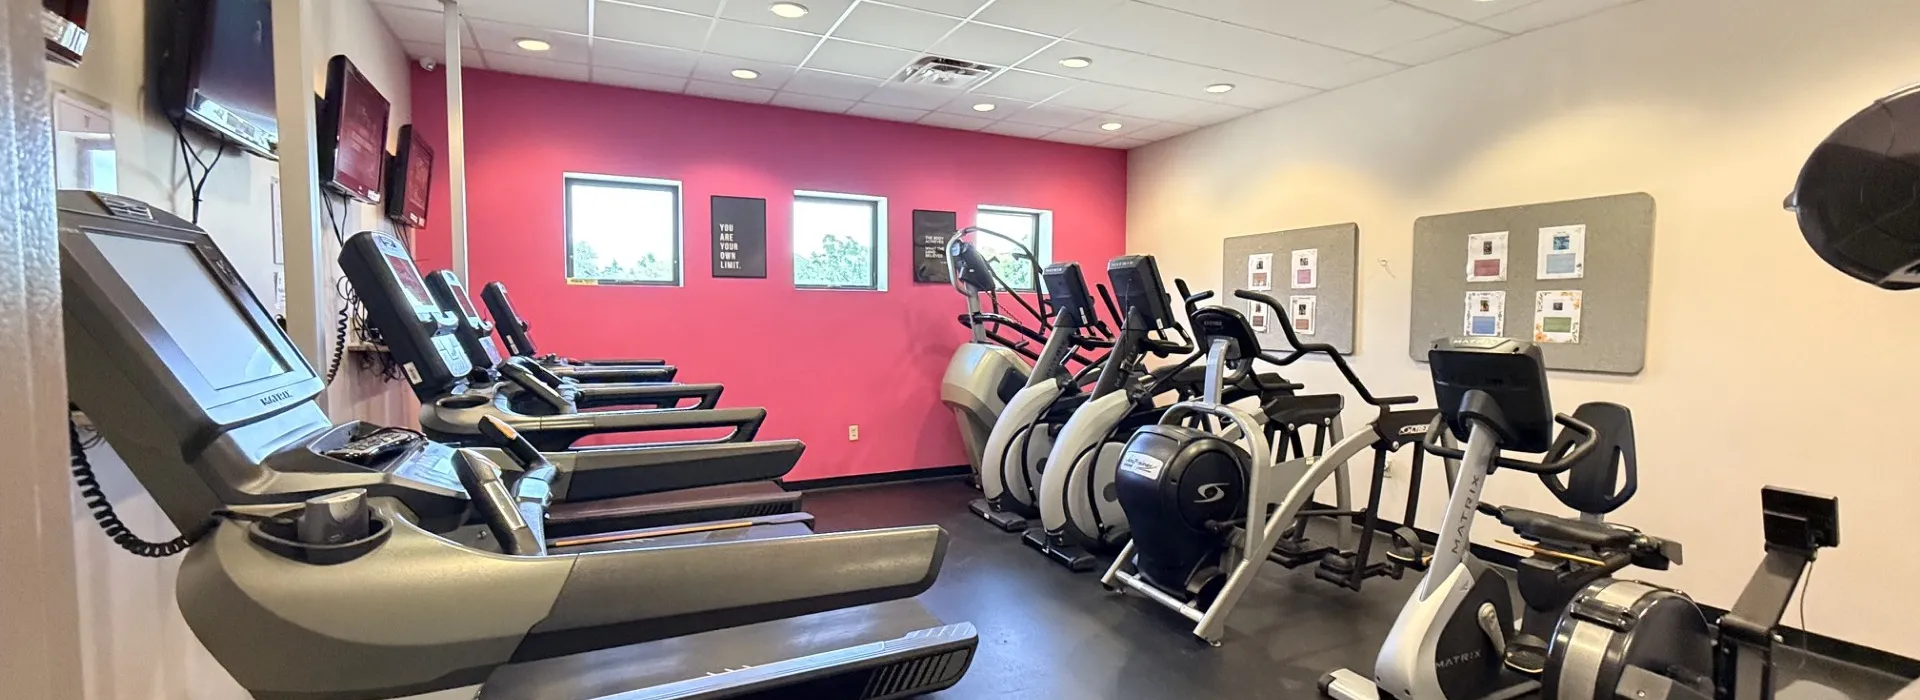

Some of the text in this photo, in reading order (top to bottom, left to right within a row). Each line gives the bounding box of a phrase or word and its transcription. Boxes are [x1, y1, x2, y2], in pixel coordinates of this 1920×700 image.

[719, 223, 734, 232] YOU
[719, 232, 734, 241] ARE
[720, 242, 738, 250] YOUR
[720, 251, 736, 260] OWN
[720, 260, 742, 270] LIMIT.
[1451, 475, 1480, 554] MATRIX
[1436, 650, 1482, 668] MATRIX
